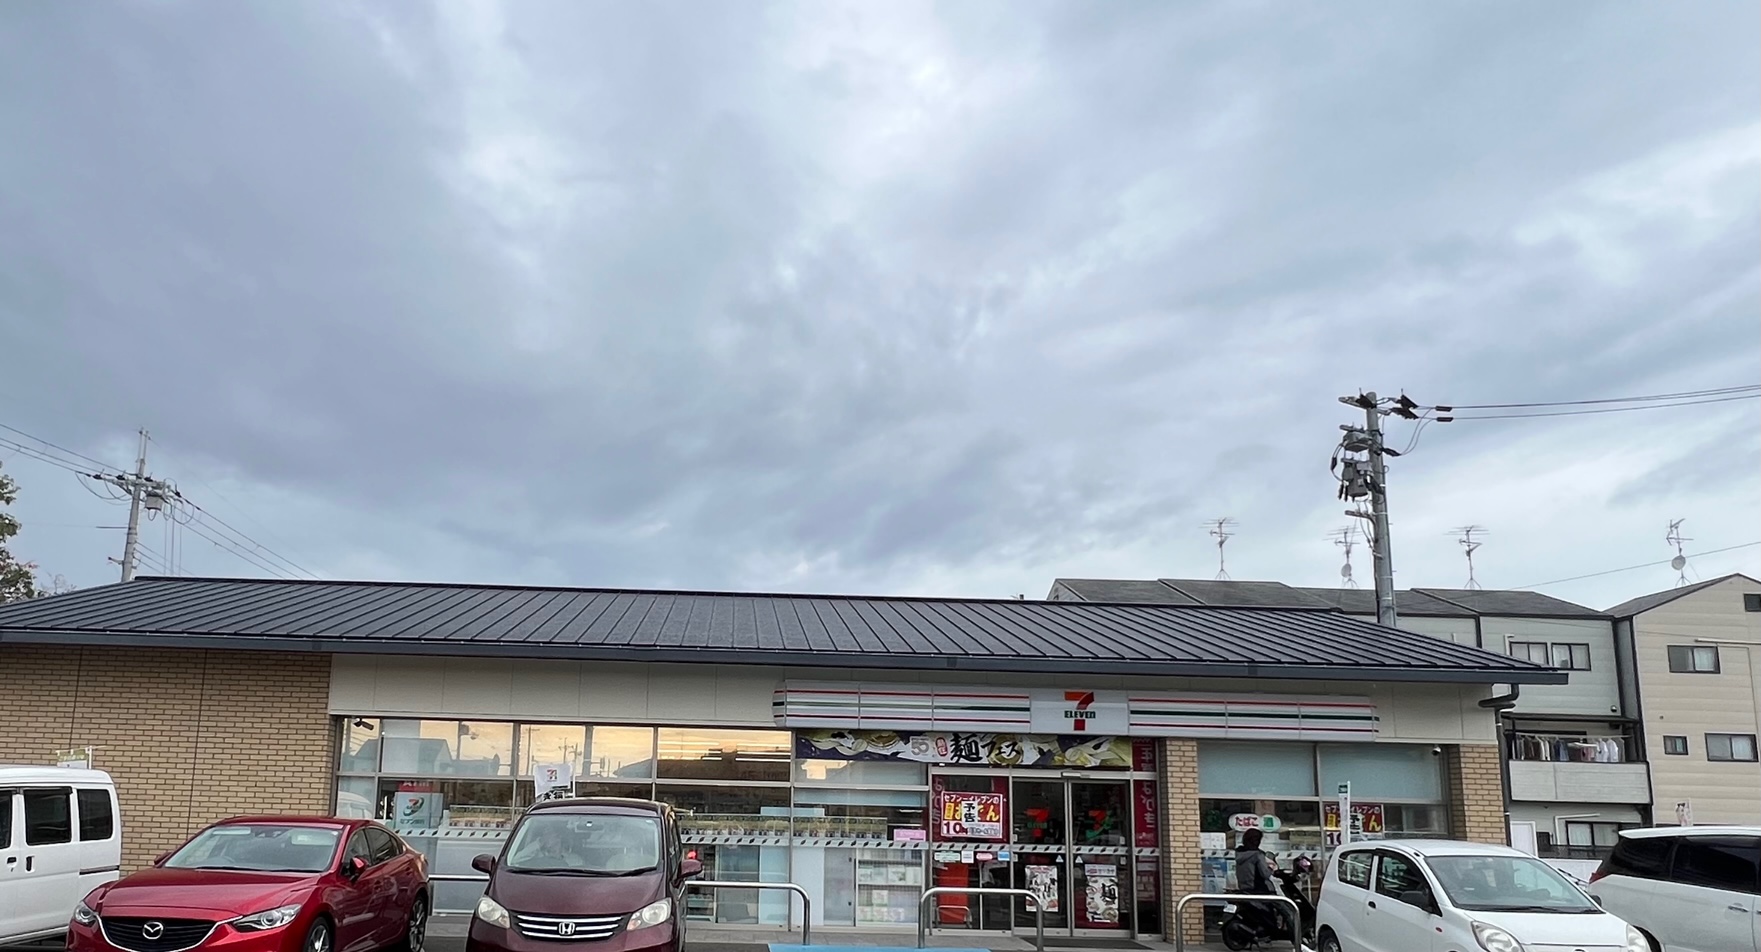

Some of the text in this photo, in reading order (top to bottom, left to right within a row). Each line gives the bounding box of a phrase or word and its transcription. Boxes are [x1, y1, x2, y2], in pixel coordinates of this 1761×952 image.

[1064, 691, 1095, 731] 7
[950, 733, 1020, 763] 麺フェス
[964, 803, 975, 822] 予告
[1235, 816, 1259, 828] たばこ
